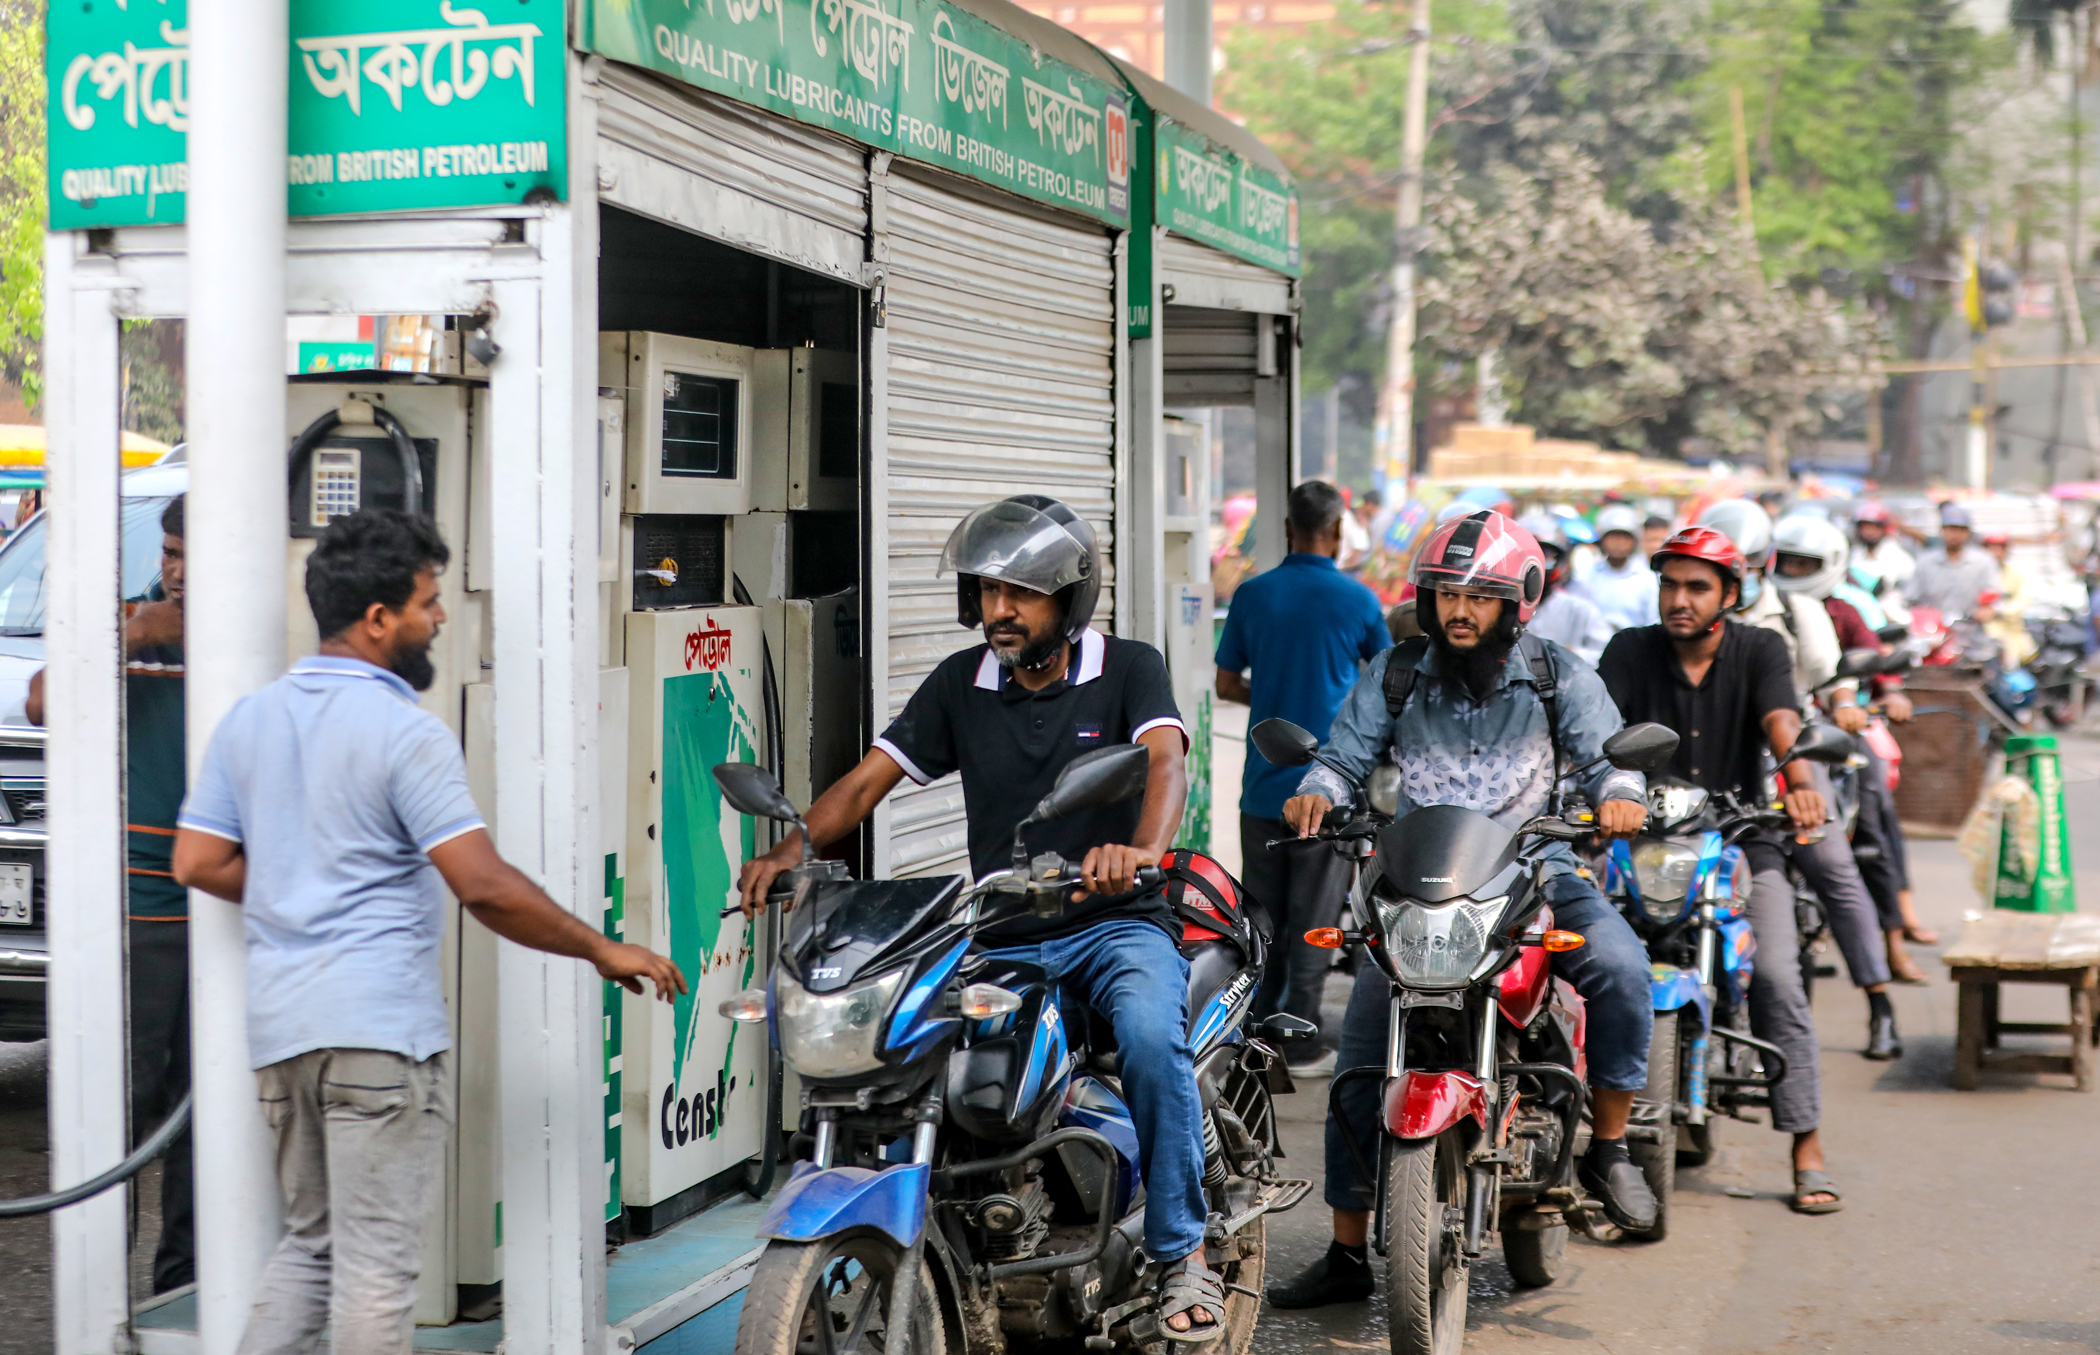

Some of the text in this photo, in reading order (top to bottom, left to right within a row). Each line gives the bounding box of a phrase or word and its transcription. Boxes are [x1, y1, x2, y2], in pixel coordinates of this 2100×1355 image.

[295, 0, 544, 117] অকটেন
[930, 10, 1010, 131] ডিজেল
[1021, 75, 1102, 169] অকটেন
[654, 24, 1105, 210] QUALITY LUBRICANTS FROM BRITISH PETROLEUM
[61, 140, 548, 201] QUALITY LUB ROM BRITISH PETROLEUM
[811, 967, 842, 980] TVS
[1219, 973, 1251, 1010] Stryker
[1042, 1002, 1060, 1031] TVS
[1084, 1276, 1102, 1297] TVS
